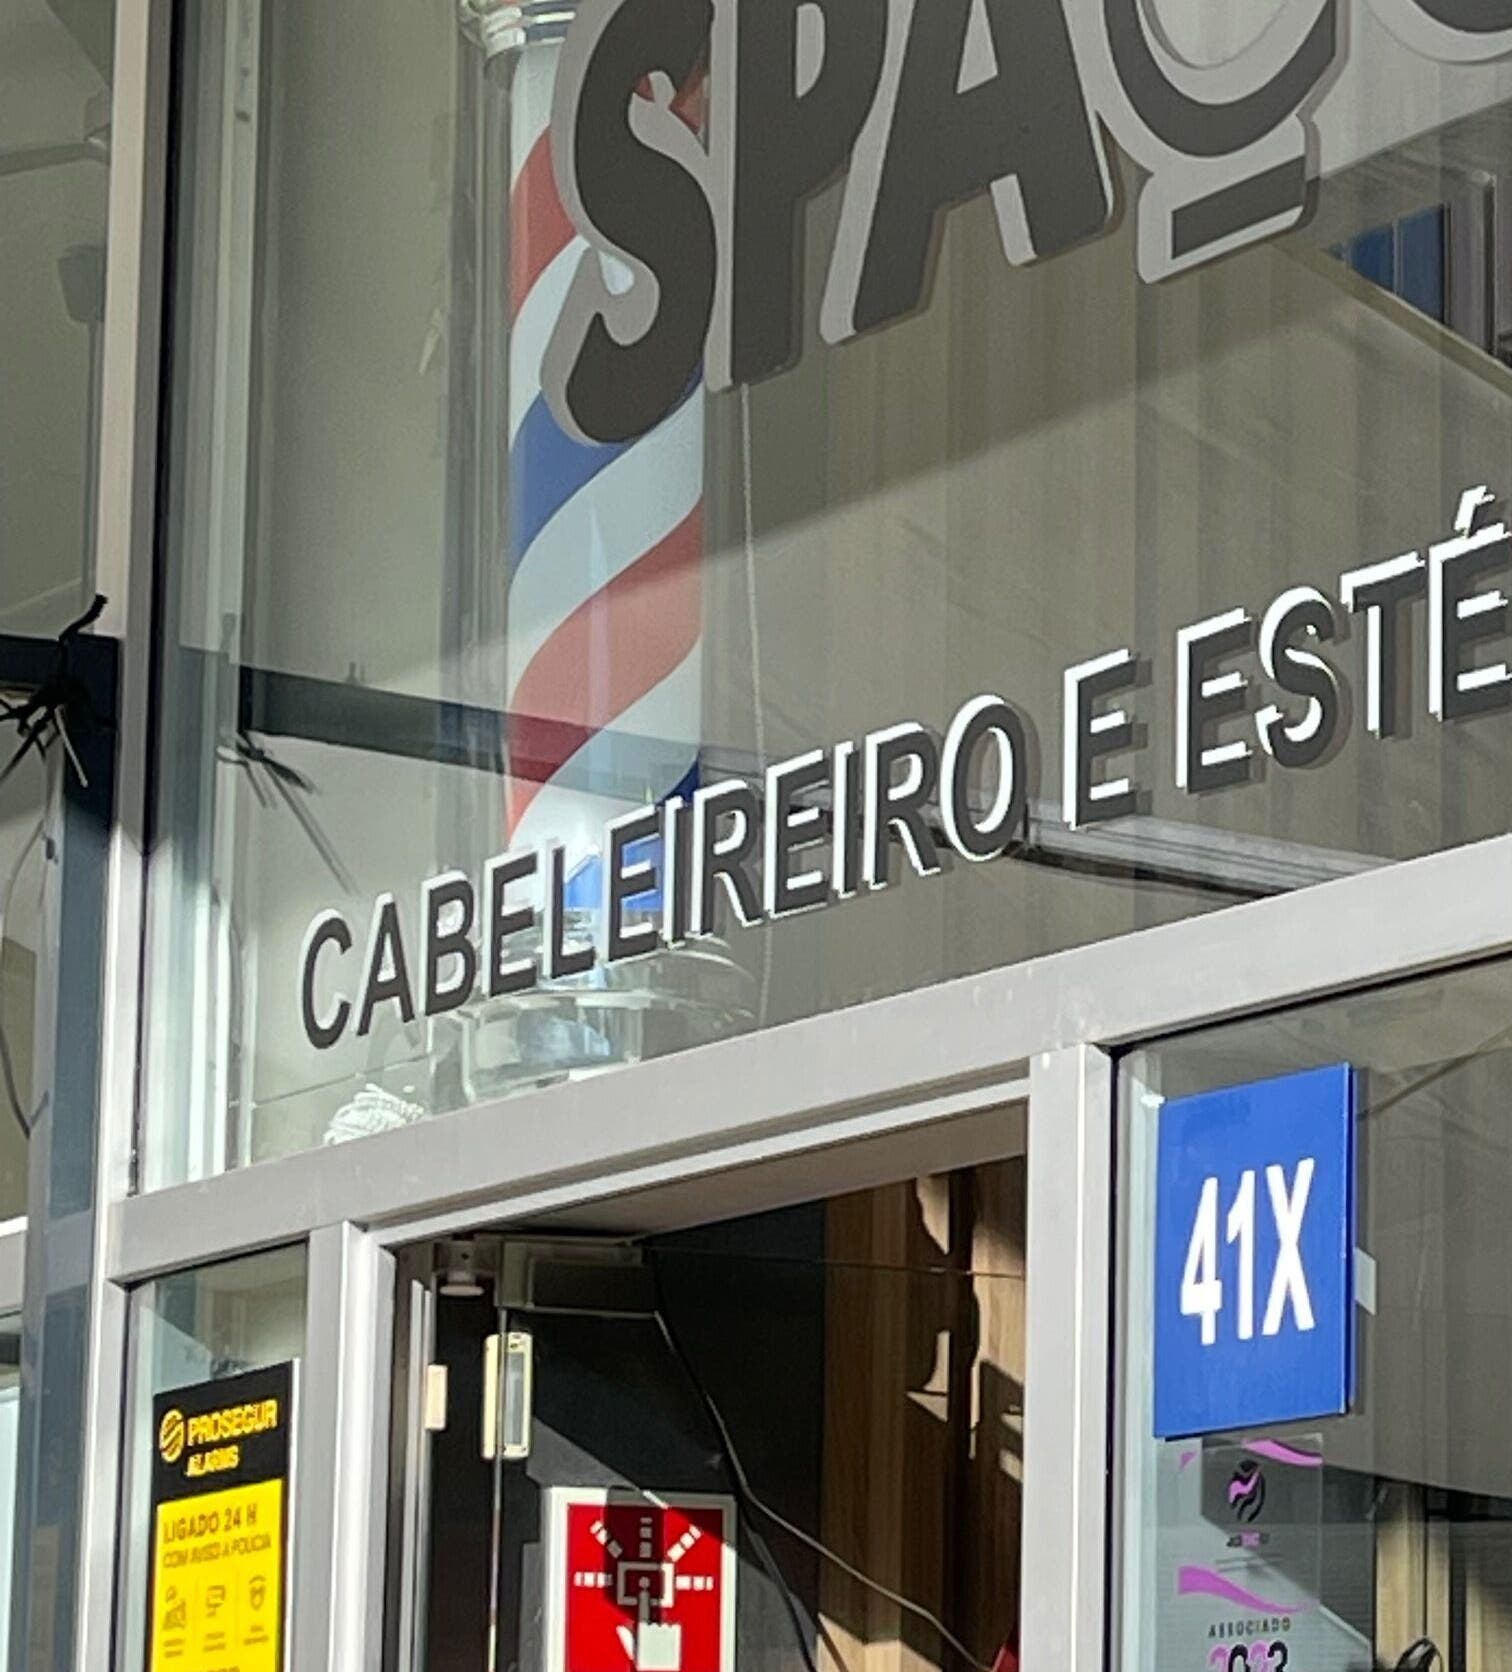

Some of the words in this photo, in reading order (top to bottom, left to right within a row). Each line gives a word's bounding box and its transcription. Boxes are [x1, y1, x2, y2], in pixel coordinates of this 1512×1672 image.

[299, 694, 1029, 1050] CABELEIREIRO
[1062, 648, 1137, 831] E
[1180, 1157, 1316, 1346] 41X
[187, 1399, 278, 1446] PROSEGUR
[163, 1510, 219, 1544] LIGADO
[223, 1505, 242, 1531] 24
